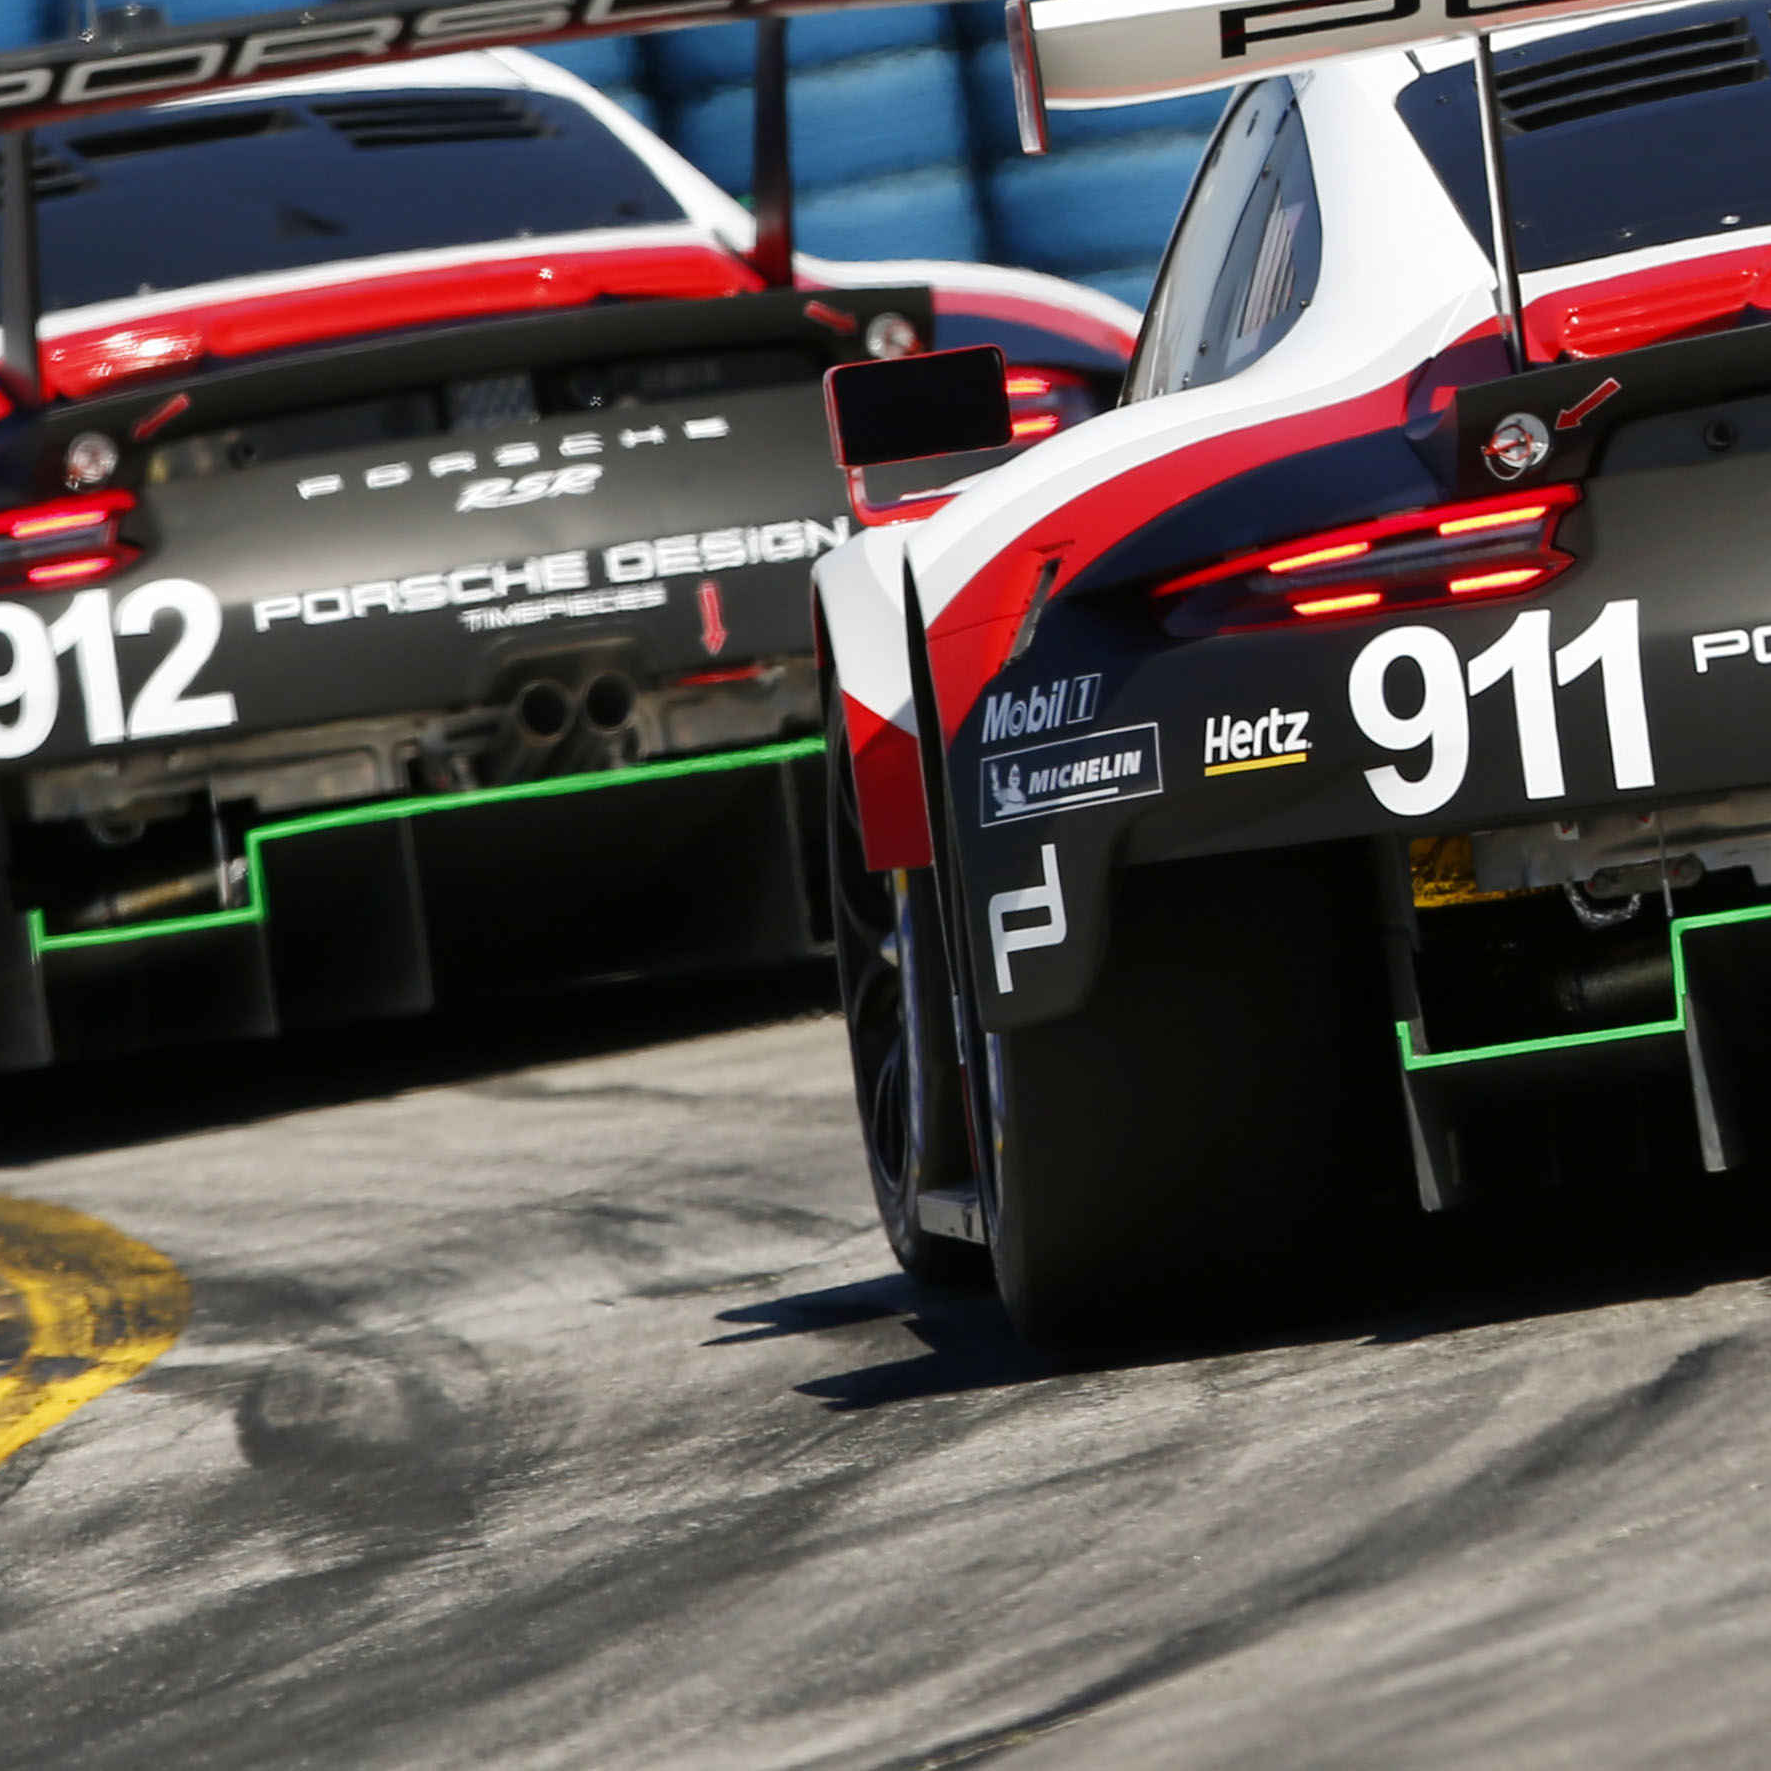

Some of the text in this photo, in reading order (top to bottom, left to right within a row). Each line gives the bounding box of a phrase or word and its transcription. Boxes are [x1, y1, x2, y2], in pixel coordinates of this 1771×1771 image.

[297, 416, 731, 499] PORSCHE
[455, 462, 604, 514] RSR
[252, 516, 849, 633] PORSCHE DESIGN
[458, 581, 667, 633] TIMEPIECES
[982, 679, 1068, 743] Mobil
[1203, 707, 1310, 765] Hertz
[1348, 599, 1656, 817] 911
[1028, 750, 1142, 795] MICHELIN
